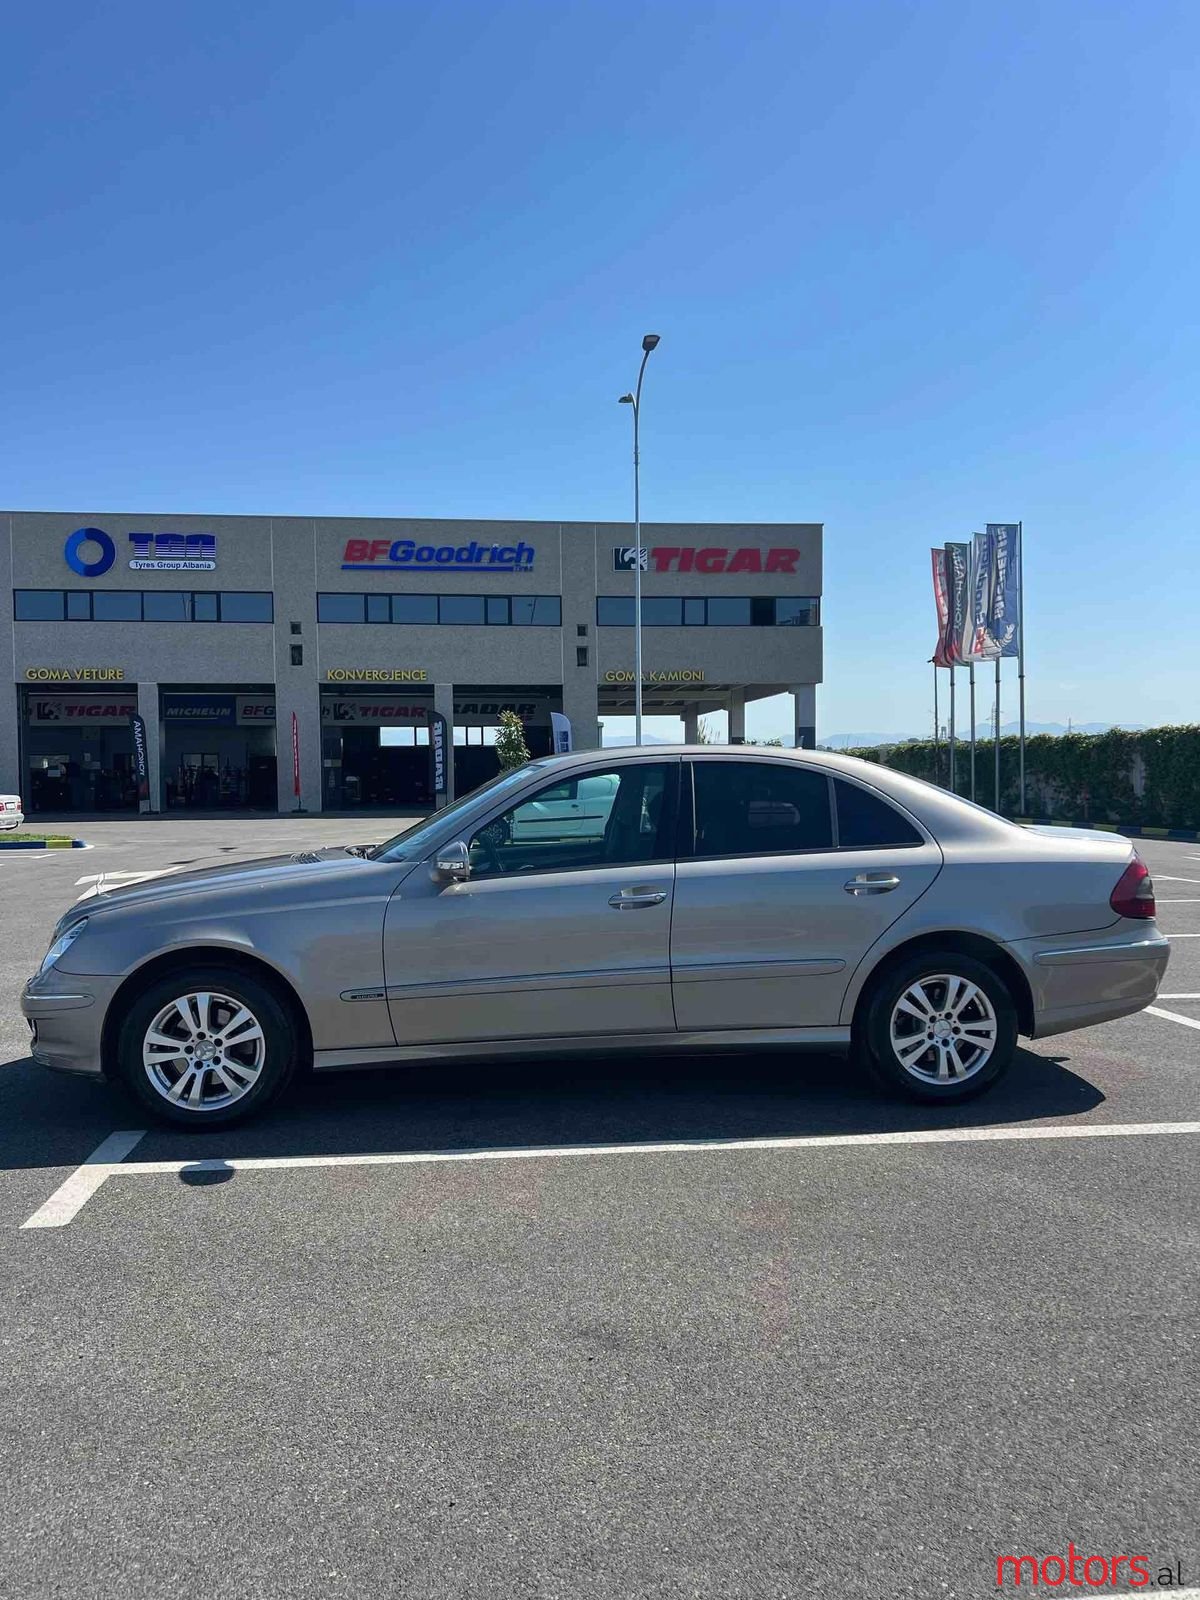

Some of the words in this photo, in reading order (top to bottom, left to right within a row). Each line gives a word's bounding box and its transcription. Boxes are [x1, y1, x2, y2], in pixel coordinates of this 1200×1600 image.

[129, 533, 216, 558] TGA
[343, 539, 535, 564] BFGoodrich
[134, 561, 155, 570] Tyres
[157, 561, 180, 570] Group
[182, 561, 211, 569] Albania
[650, 547, 801, 573] TIGAR
[26, 668, 72, 680] GOMA
[75, 668, 125, 680] VETURE
[327, 669, 427, 681] KONVERGJENCE
[650, 670, 705, 681] KAMIONI
[65, 704, 136, 717] TIGAR
[166, 707, 231, 717] MICHELIN
[359, 705, 426, 717] TIGAR
